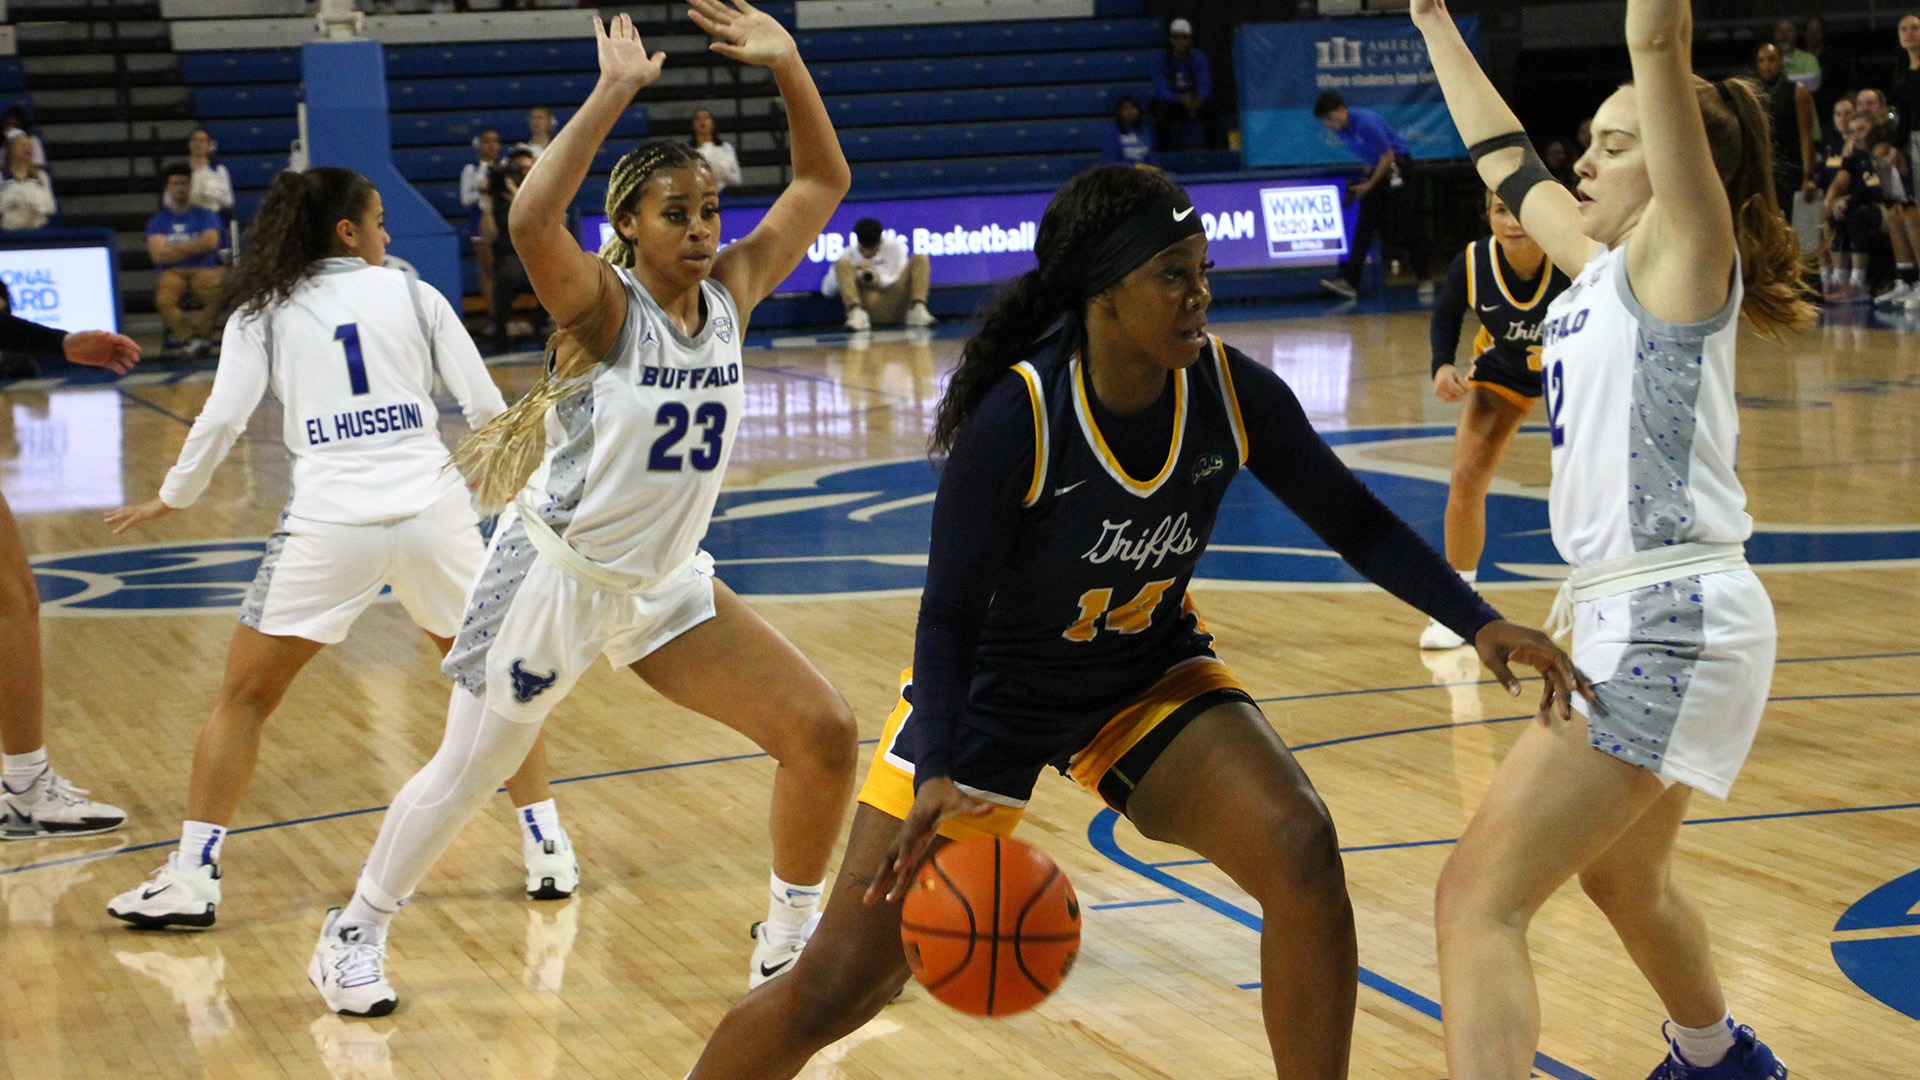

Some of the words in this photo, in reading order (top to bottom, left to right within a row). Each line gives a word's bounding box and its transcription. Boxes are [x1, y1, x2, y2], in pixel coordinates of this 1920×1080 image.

[1269, 194, 1333, 216] WWKB
[1311, 217, 1335, 233] AM
[912, 221, 1036, 256] Basketball
[333, 322, 370, 396] 1
[636, 362, 739, 390] BUFFALO
[306, 417, 330, 446] EL
[334, 402, 423, 441] HUSSEINI
[646, 401, 728, 472] 23
[1080, 511, 1199, 572] Griffs
[1061, 576, 1178, 642] 14
